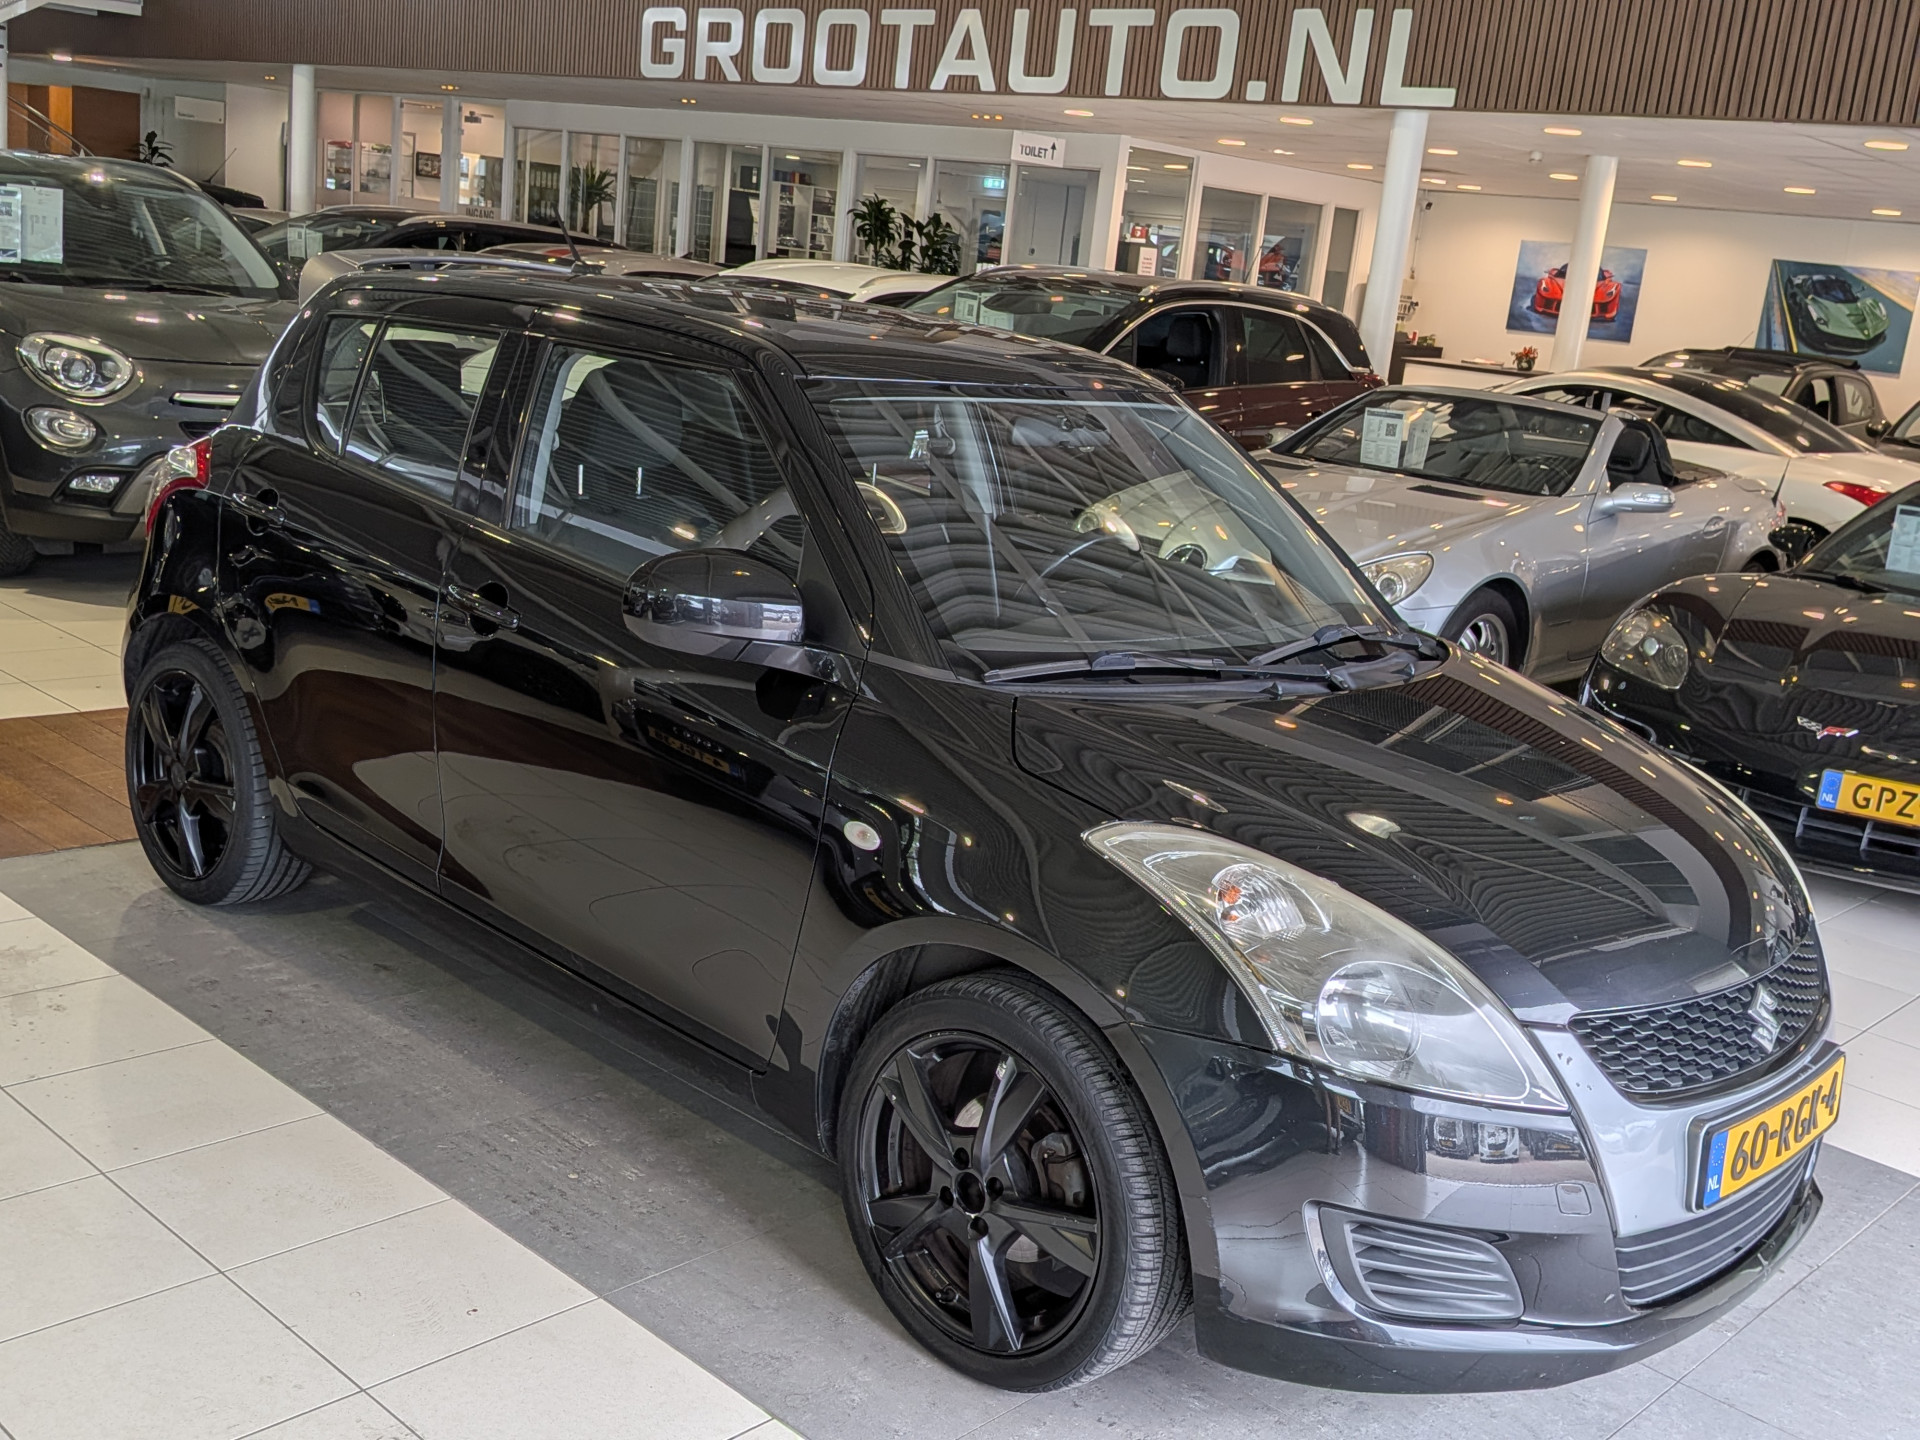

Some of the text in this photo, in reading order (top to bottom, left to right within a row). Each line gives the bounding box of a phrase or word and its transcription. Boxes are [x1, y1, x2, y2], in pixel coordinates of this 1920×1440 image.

[640, 7, 1457, 108] GROOTAUTO.NL
[1020, 144, 1048, 159] TOILET
[466, 208, 494, 219] INGANG
[1821, 792, 1835, 803] NL
[1731, 1071, 1839, 1181] 60-RGK-4
[1707, 1174, 1720, 1193] NL
